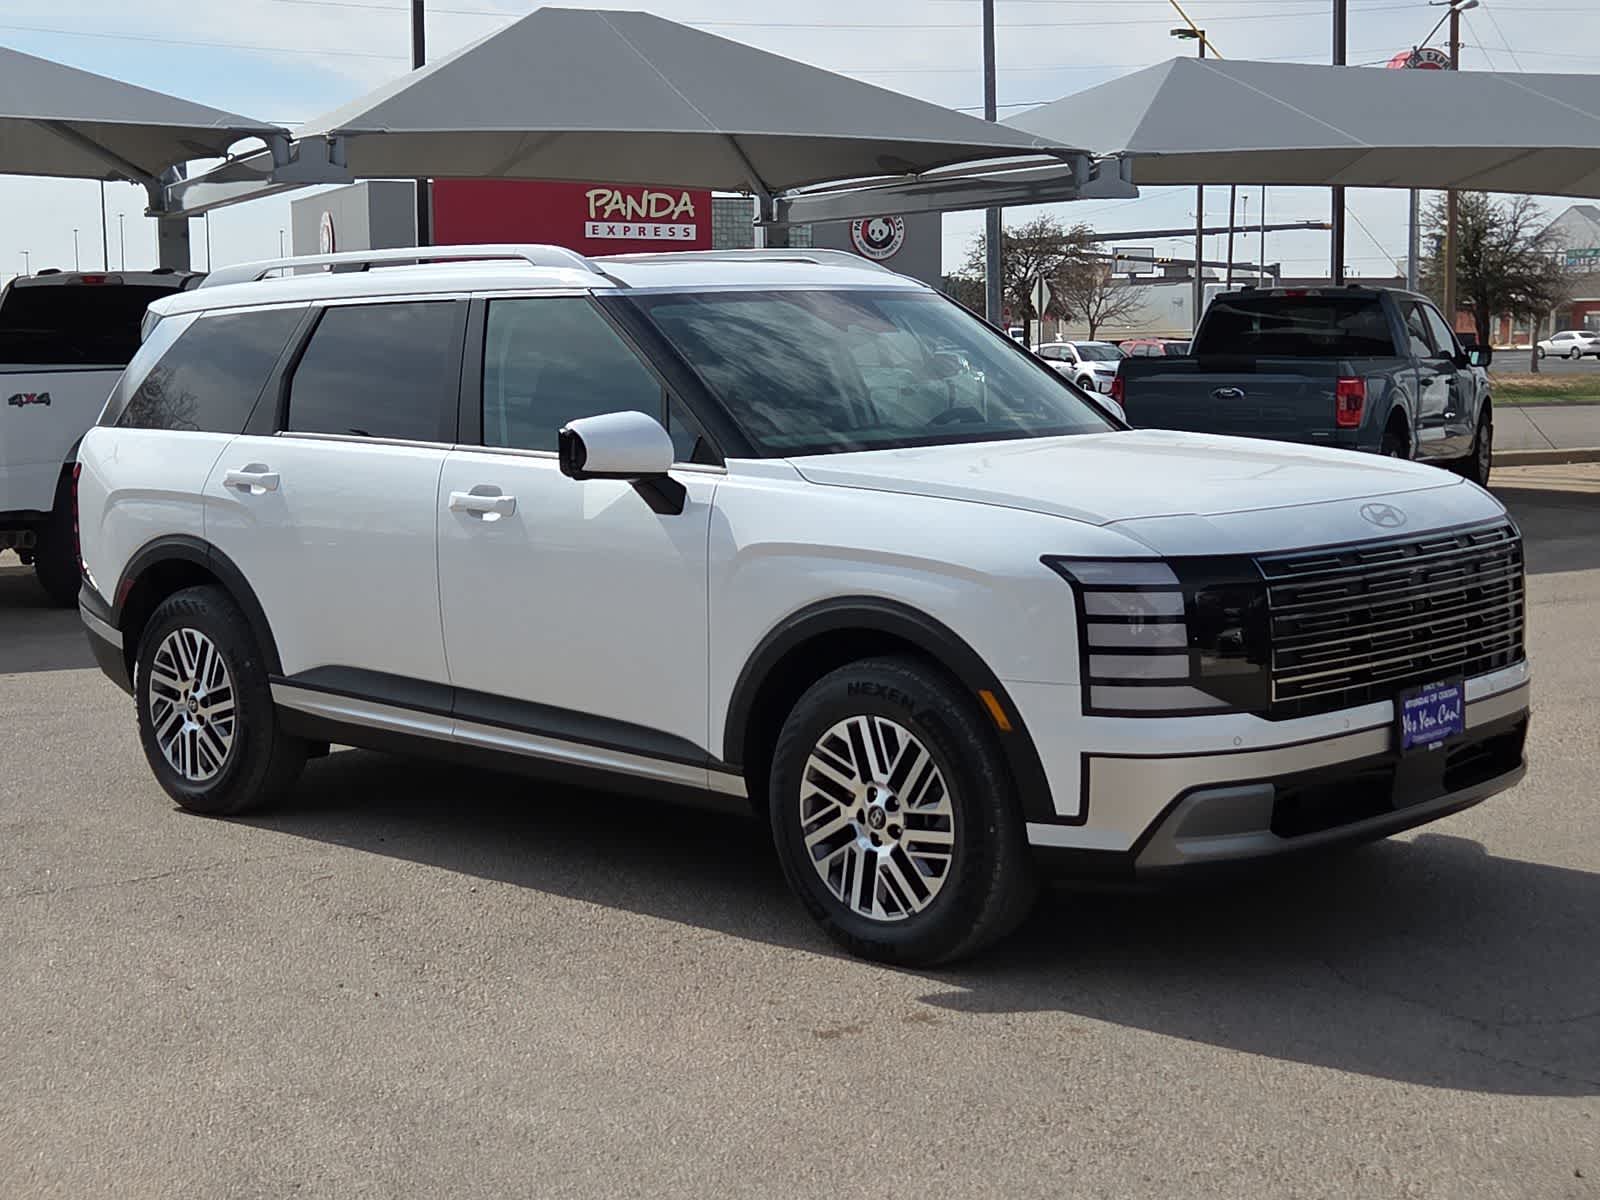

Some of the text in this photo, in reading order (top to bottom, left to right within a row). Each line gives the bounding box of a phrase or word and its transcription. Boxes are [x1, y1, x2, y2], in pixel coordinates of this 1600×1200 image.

[585, 188, 695, 221] PANDA
[591, 225, 691, 237] EXPRESS
[847, 680, 914, 705] NEXEN
[1402, 713, 1417, 736] Yes
[1419, 709, 1437, 731] You
[1437, 698, 1460, 724] Can!
